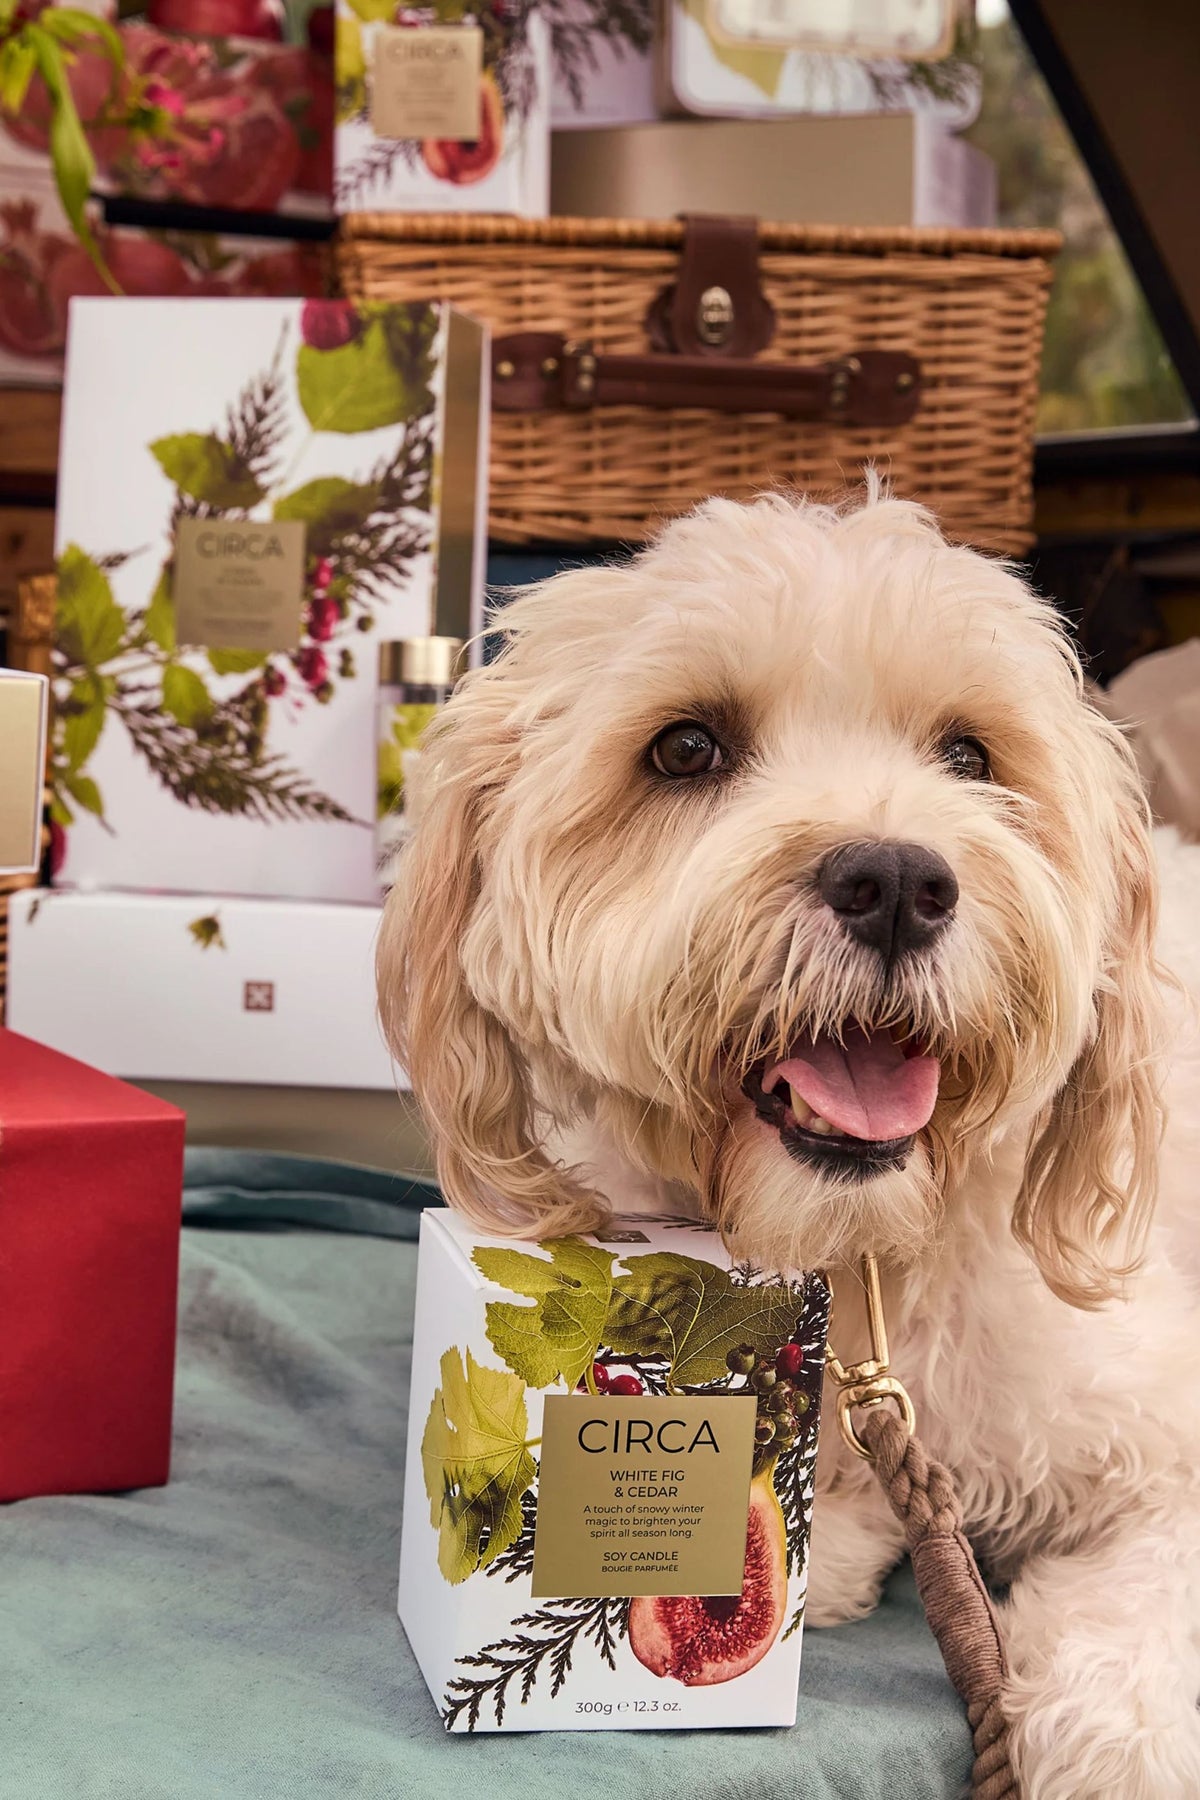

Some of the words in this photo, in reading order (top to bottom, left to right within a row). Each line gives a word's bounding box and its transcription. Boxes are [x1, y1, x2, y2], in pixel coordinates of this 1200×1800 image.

[195, 531, 285, 560] CIRCA
[577, 1419, 720, 1454] CIRCA
[609, 1470, 658, 1482] WHITE
[661, 1469, 685, 1482] FIG
[614, 1486, 624, 1498] &
[627, 1486, 678, 1498] CEDAR
[583, 1505, 592, 1514] A
[593, 1504, 623, 1514] touch
[625, 1504, 637, 1514] of
[637, 1506, 670, 1516] snowy
[672, 1504, 705, 1514] winter
[585, 1516, 617, 1527] magic
[619, 1516, 631, 1526] to
[632, 1516, 676, 1527] brighten
[677, 1517, 702, 1527] your
[589, 1528, 616, 1539] spirit
[617, 1528, 630, 1538] all
[631, 1529, 667, 1538] season
[669, 1528, 694, 1539] long.
[603, 1551, 628, 1562] SOY
[629, 1551, 679, 1562] CANDLE
[601, 1565, 633, 1573] BOUGIE
[634, 1563, 679, 1573] PARFUMÉE
[575, 1701, 613, 1716] 300g
[633, 1700, 659, 1713] 12.3
[662, 1702, 682, 1712] oz.
